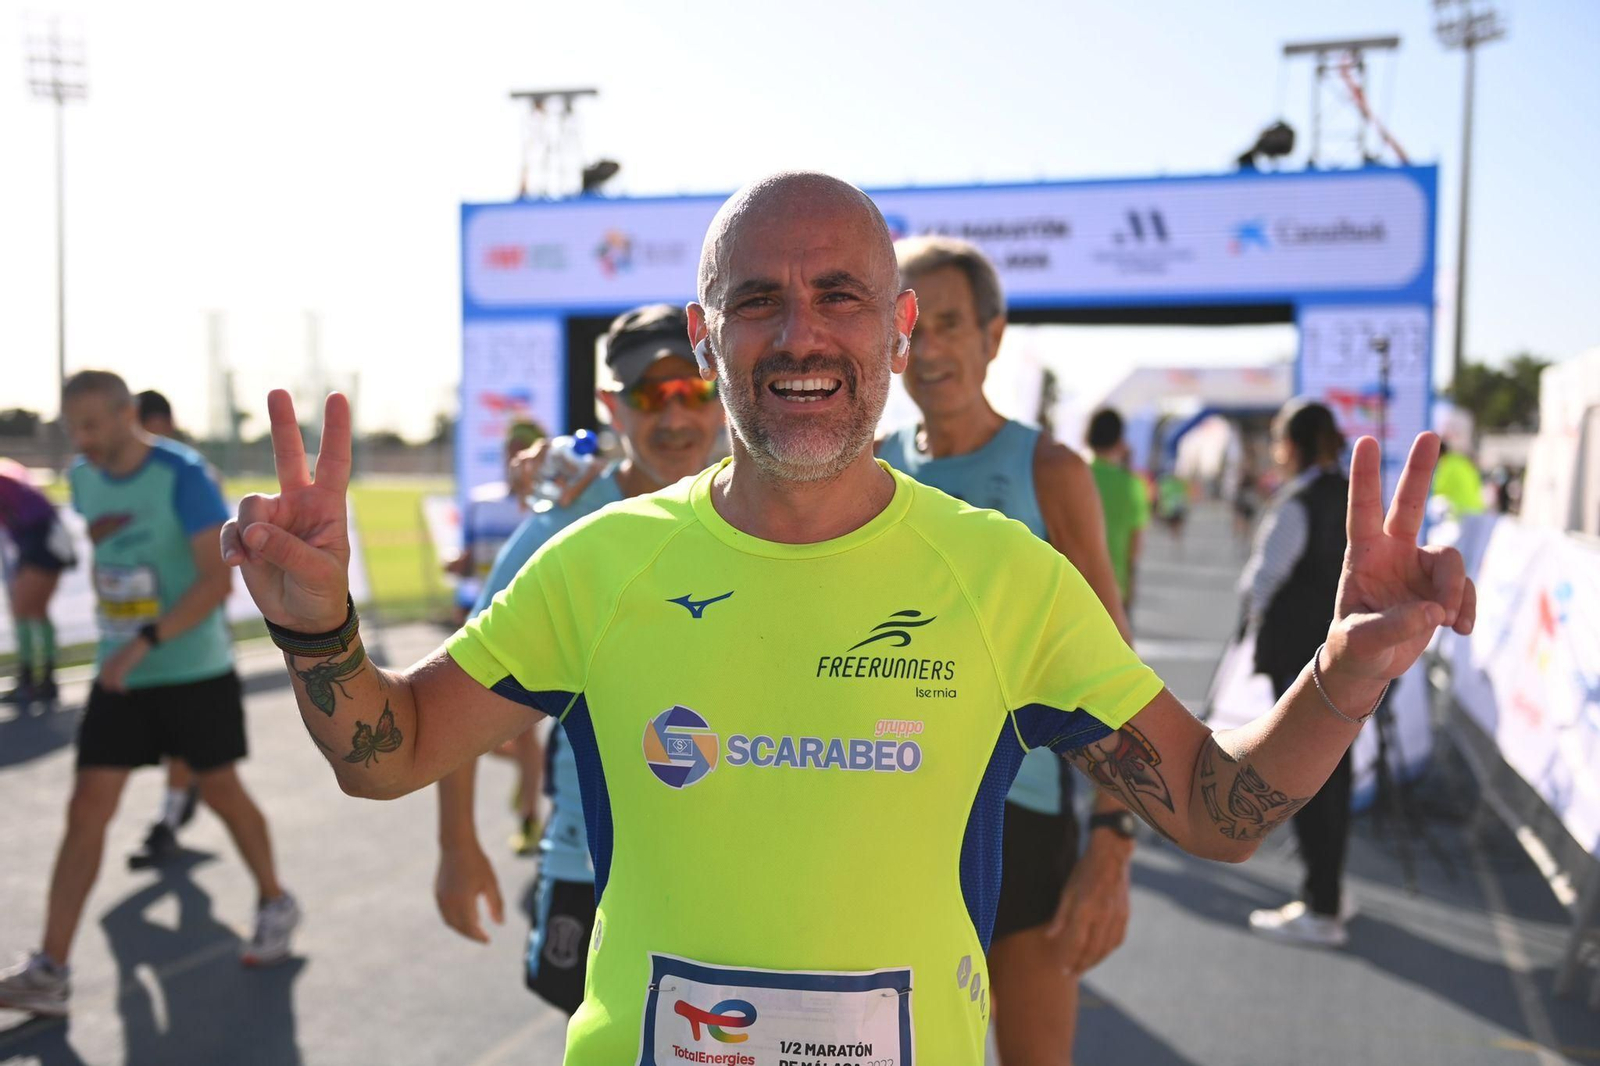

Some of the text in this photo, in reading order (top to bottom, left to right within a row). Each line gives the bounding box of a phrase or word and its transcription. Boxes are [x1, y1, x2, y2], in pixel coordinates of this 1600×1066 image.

[816, 656, 956, 681] FREERUNNERS
[915, 687, 957, 698] Isernia
[875, 719, 923, 737] gruppo
[725, 734, 922, 773] SCARABEO
[672, 1044, 756, 1066] TotalEnergies
[780, 1041, 873, 1057] 1/2 MARATÓN
